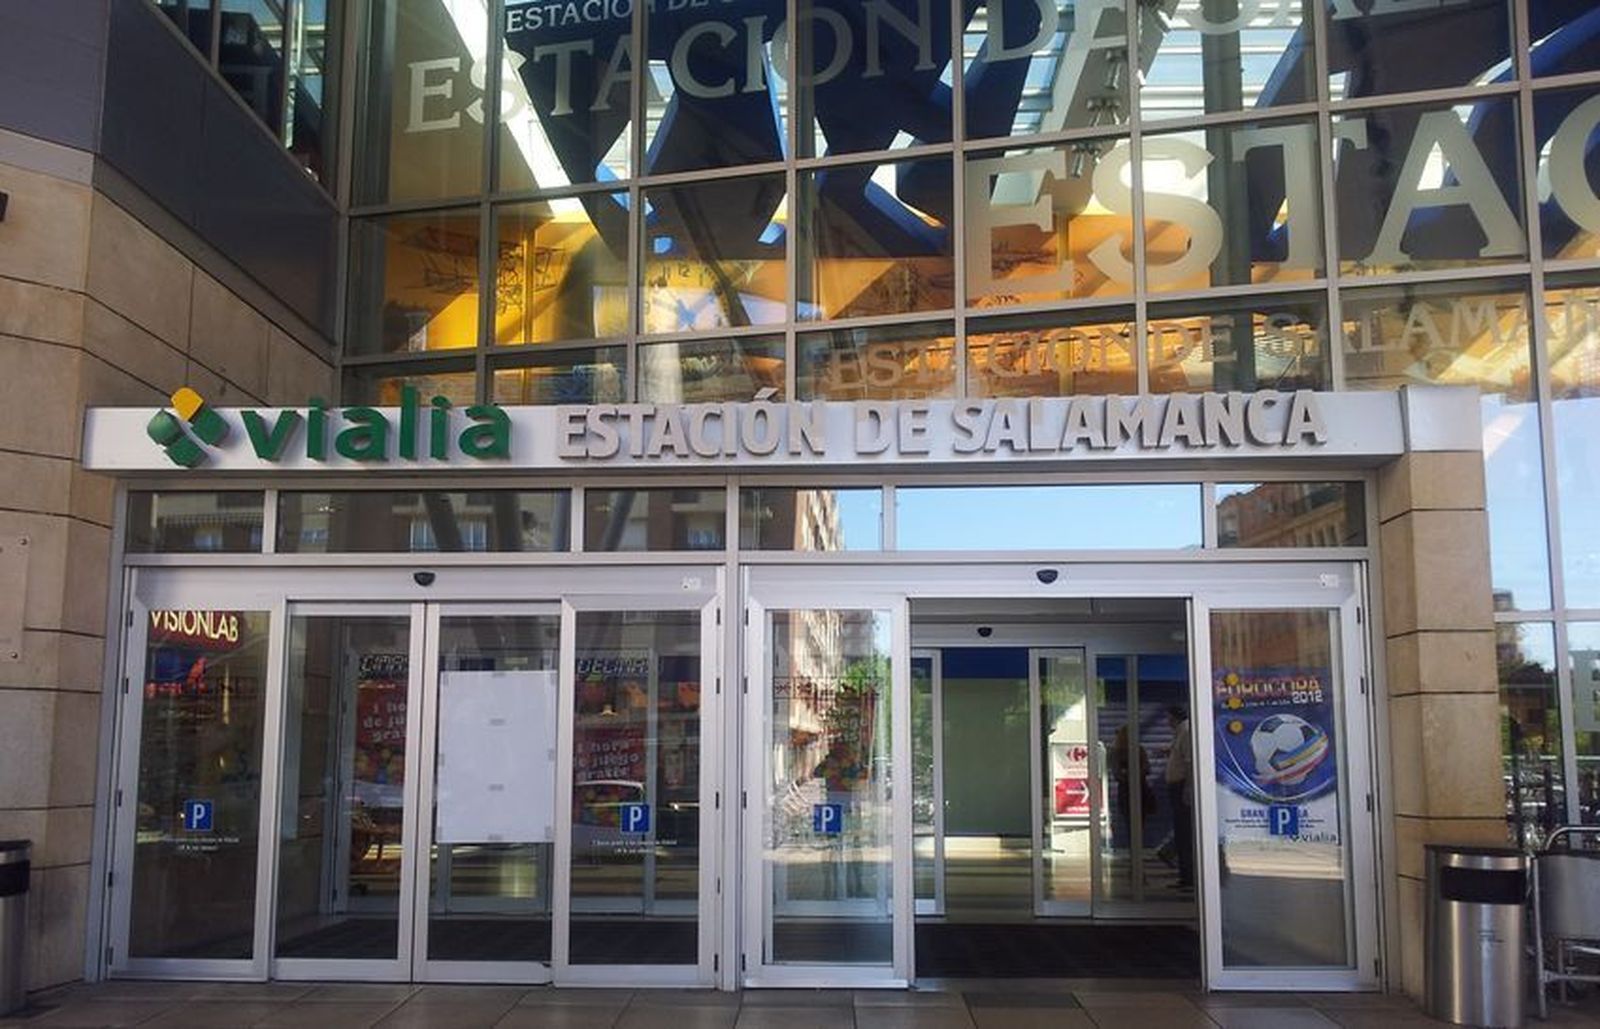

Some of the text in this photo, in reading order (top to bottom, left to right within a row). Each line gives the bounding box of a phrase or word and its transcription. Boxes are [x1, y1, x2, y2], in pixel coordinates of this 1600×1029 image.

[505, 0, 656, 33] ESTACIO
[242, 385, 1328, 463] vialia ESTACIÓN DE SALAMANCA
[151, 610, 239, 642] VISIONLAB
[1292, 689, 1323, 704] 2012
